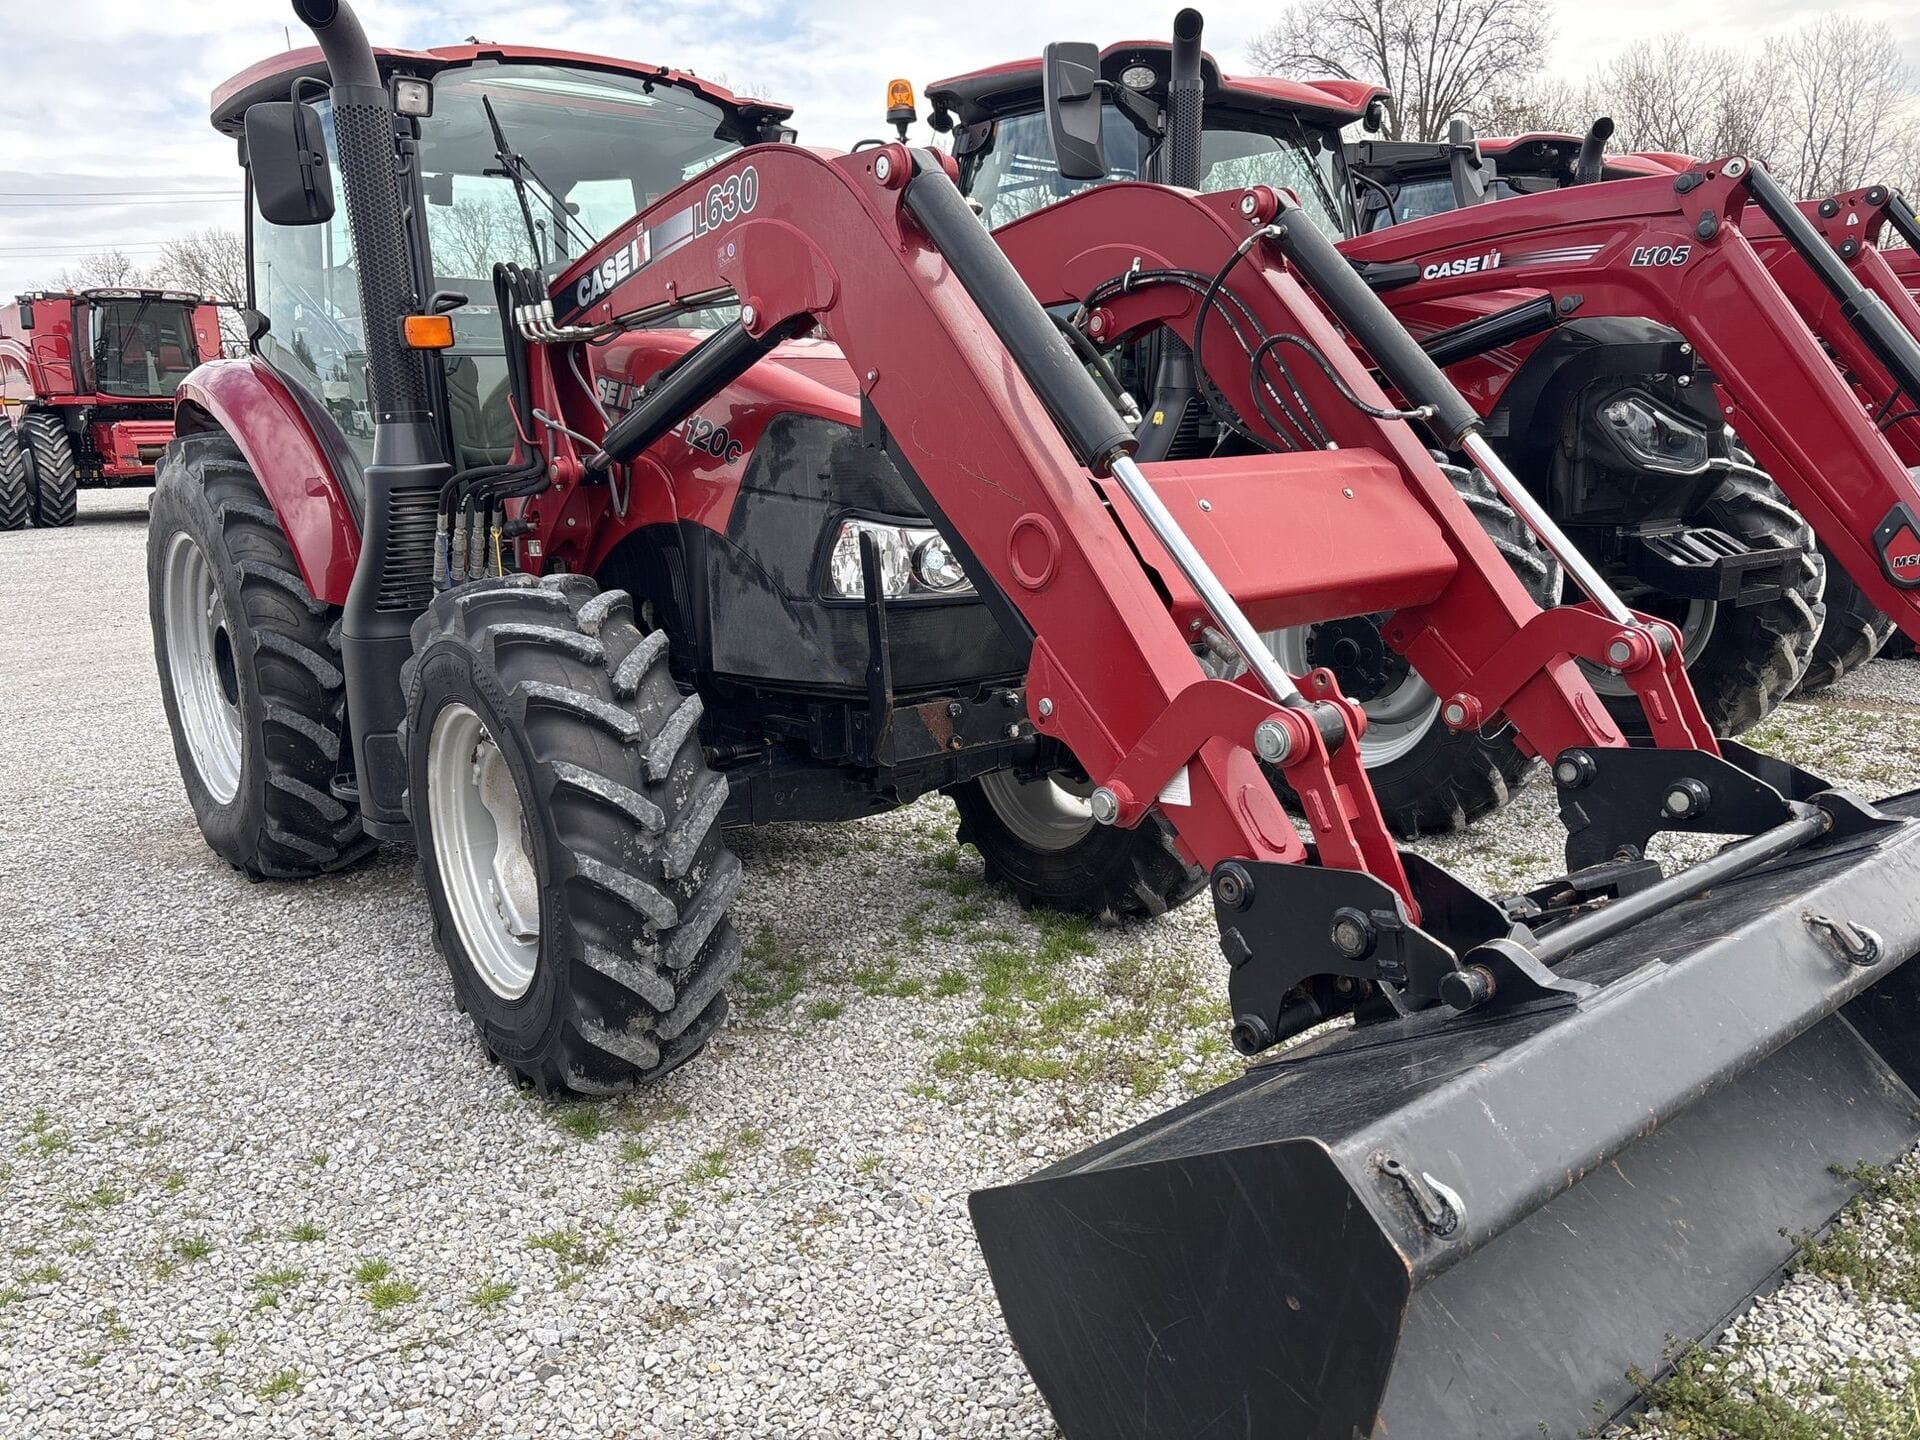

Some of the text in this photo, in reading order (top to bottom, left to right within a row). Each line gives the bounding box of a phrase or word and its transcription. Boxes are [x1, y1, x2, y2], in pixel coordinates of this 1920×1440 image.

[694, 166, 759, 239] L630
[1423, 256, 1480, 280] CASE
[1629, 245, 1692, 267] L105
[577, 245, 631, 307] CASE
[596, 378, 619, 406] SE
